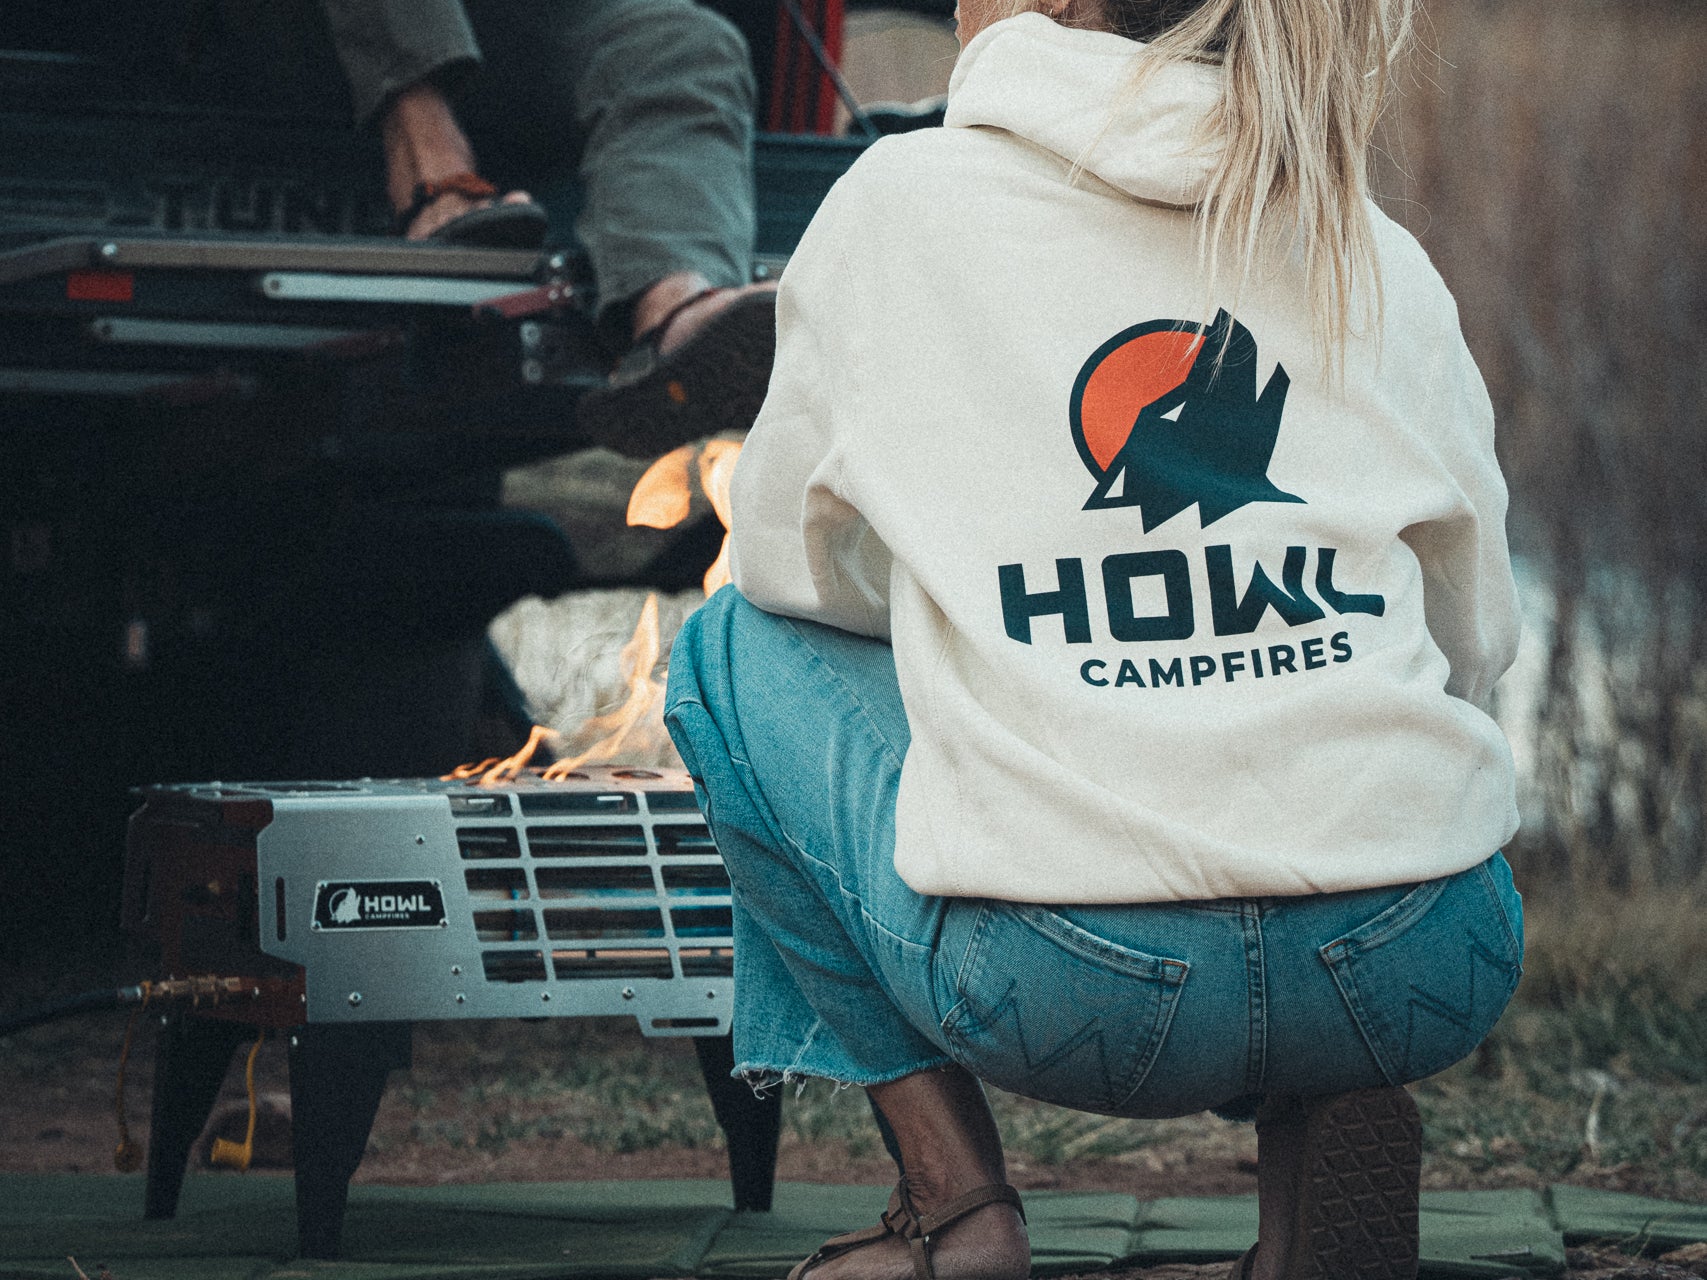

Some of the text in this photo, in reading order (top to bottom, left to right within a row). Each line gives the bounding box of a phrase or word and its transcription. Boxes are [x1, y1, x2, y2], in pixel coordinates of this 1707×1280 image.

[998, 544, 1385, 645] HOWL
[1080, 631, 1353, 688] CAMPFIRES
[364, 895, 431, 911] HOWL
